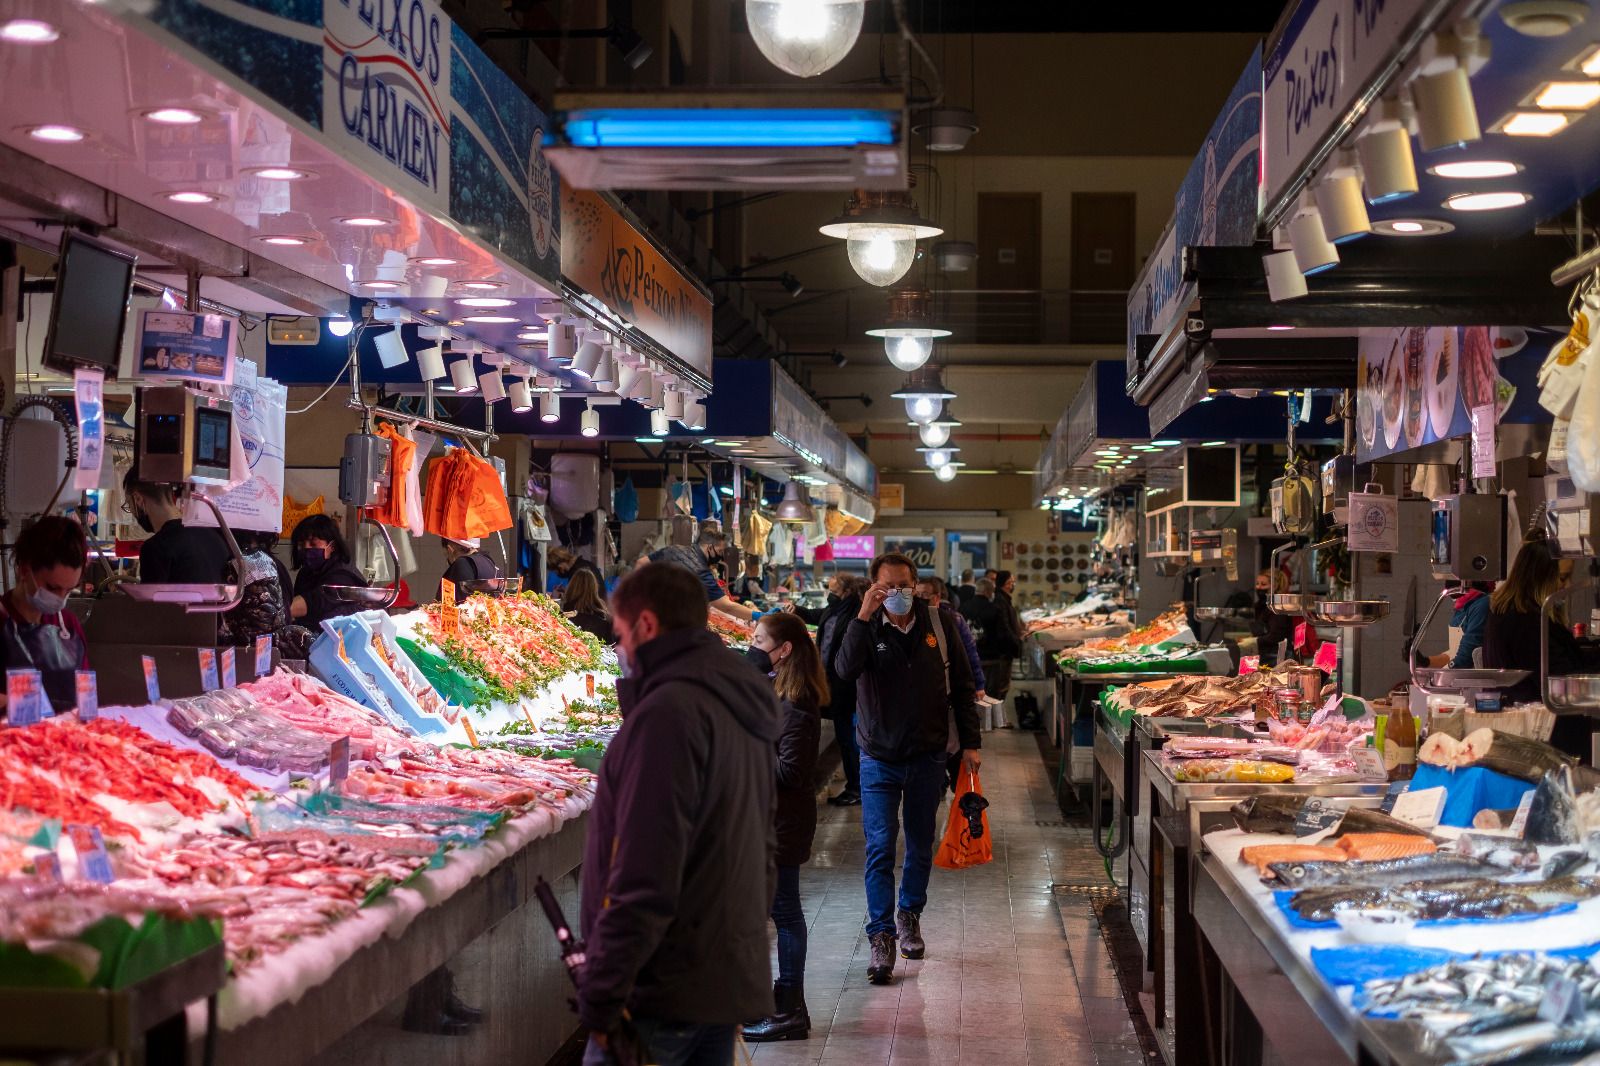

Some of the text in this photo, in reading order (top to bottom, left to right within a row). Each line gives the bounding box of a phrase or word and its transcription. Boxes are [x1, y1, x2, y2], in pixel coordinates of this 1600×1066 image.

[339, 52, 440, 194] CARMEN
[1285, 12, 1339, 156] Peixos
[633, 246, 676, 322] Peixos
